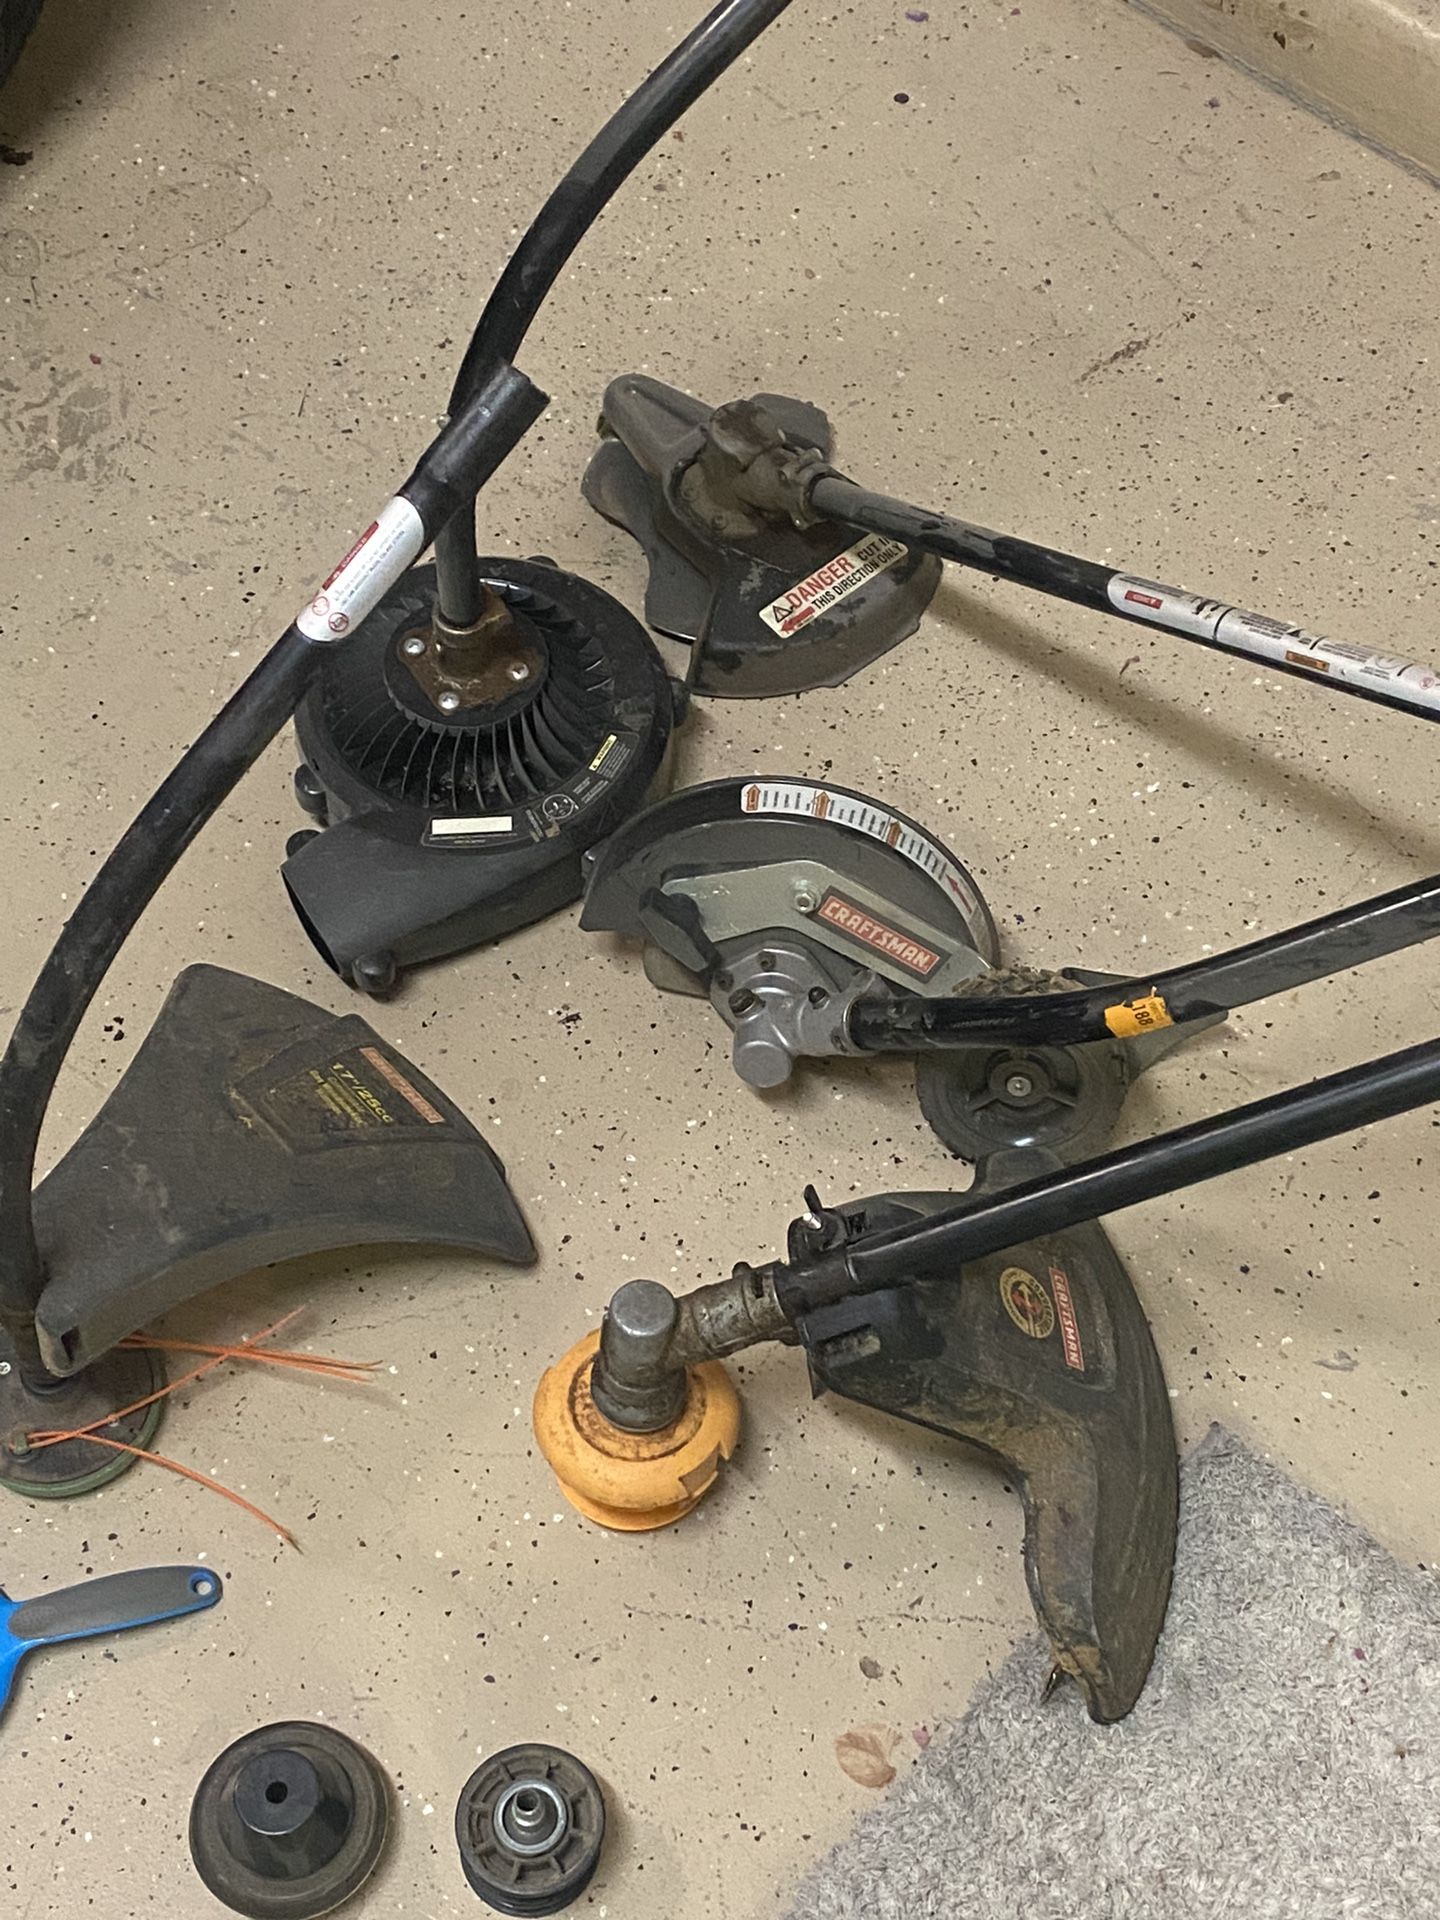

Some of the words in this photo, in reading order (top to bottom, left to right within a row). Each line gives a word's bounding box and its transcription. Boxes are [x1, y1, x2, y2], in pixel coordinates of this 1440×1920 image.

[785, 556, 855, 609] DANGER
[857, 541, 880, 561] CUT
[811, 590, 836, 610] THIS
[836, 559, 880, 596] DIRECTION
[877, 542, 903, 564] ONLY
[824, 902, 931, 968] CRAFTSMAN
[1132, 1004, 1154, 1026] 188
[1054, 1274, 1081, 1364] CRAFTSMAN
